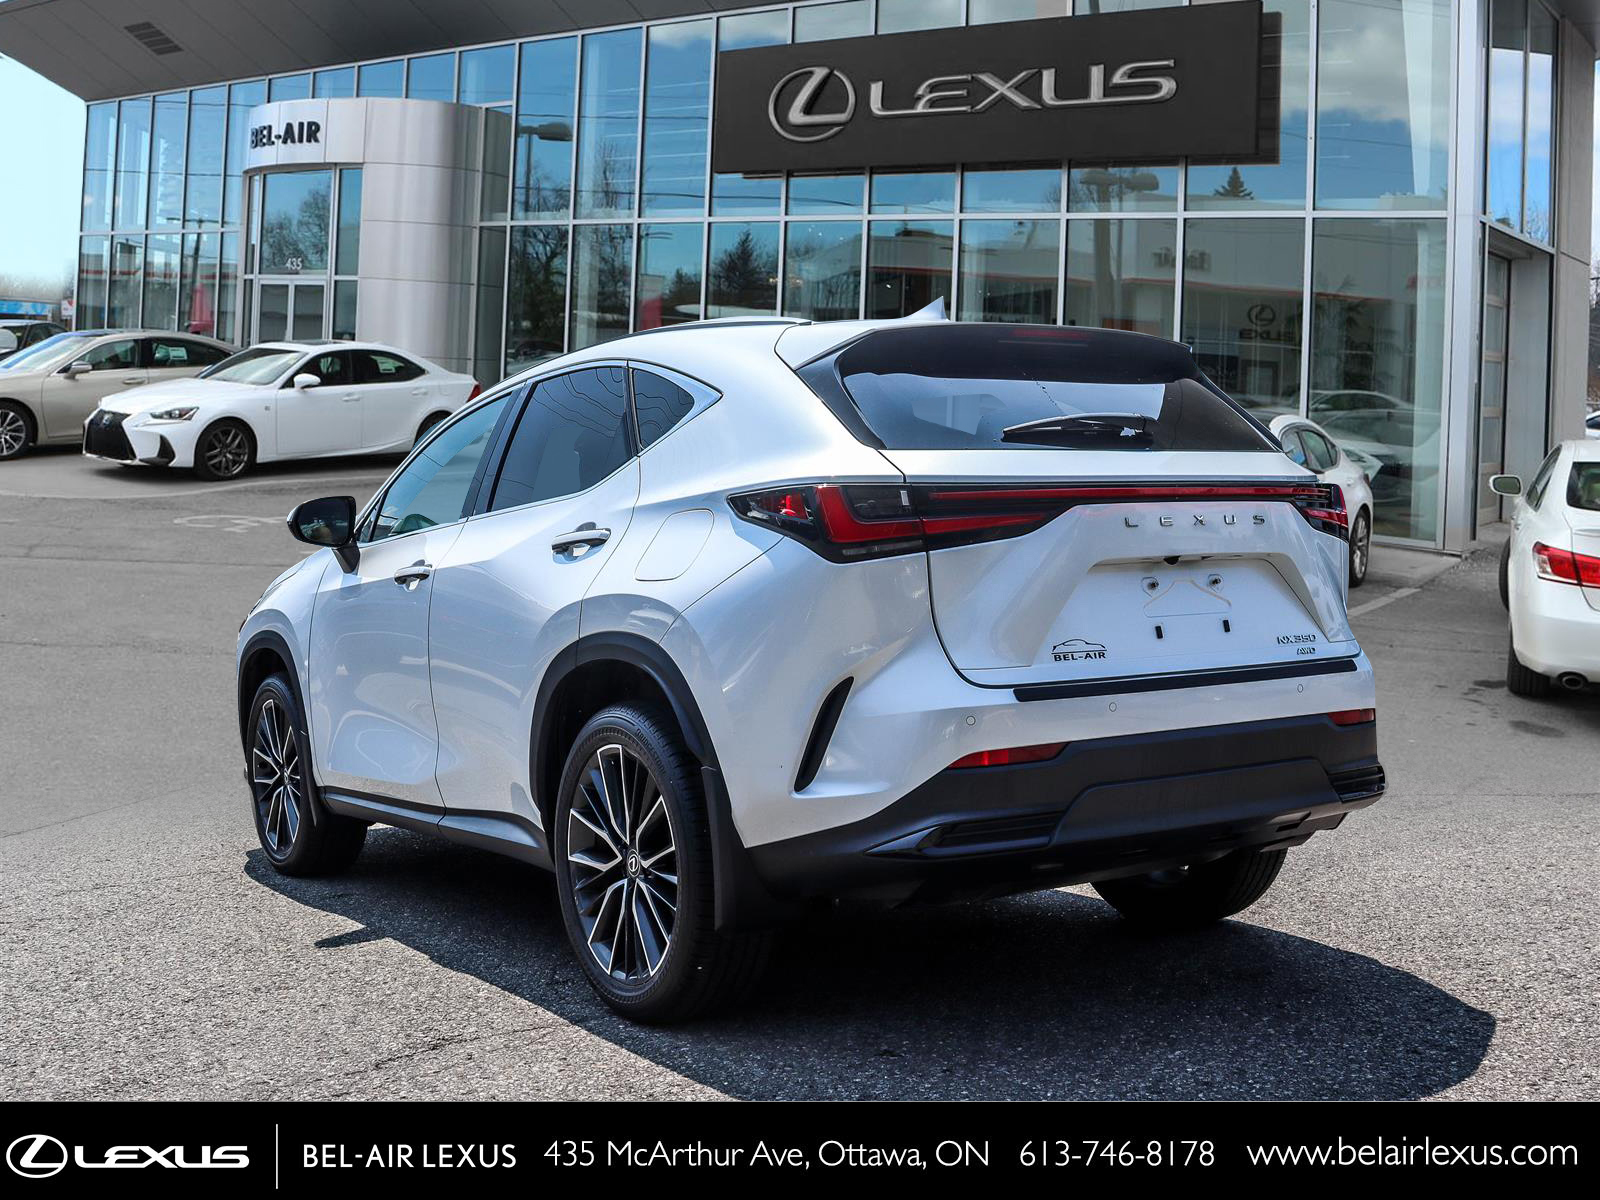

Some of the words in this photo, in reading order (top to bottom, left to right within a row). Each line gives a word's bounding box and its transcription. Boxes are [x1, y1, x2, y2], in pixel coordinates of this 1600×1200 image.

[869, 59, 1177, 118] LEXUS
[250, 120, 321, 149] BEL-AIR
[286, 257, 303, 270] 435
[1124, 514, 1266, 528] LEXUS
[1276, 634, 1317, 645] NX350
[1053, 651, 1107, 662] BEL-AIR
[1296, 647, 1316, 656] AWD
